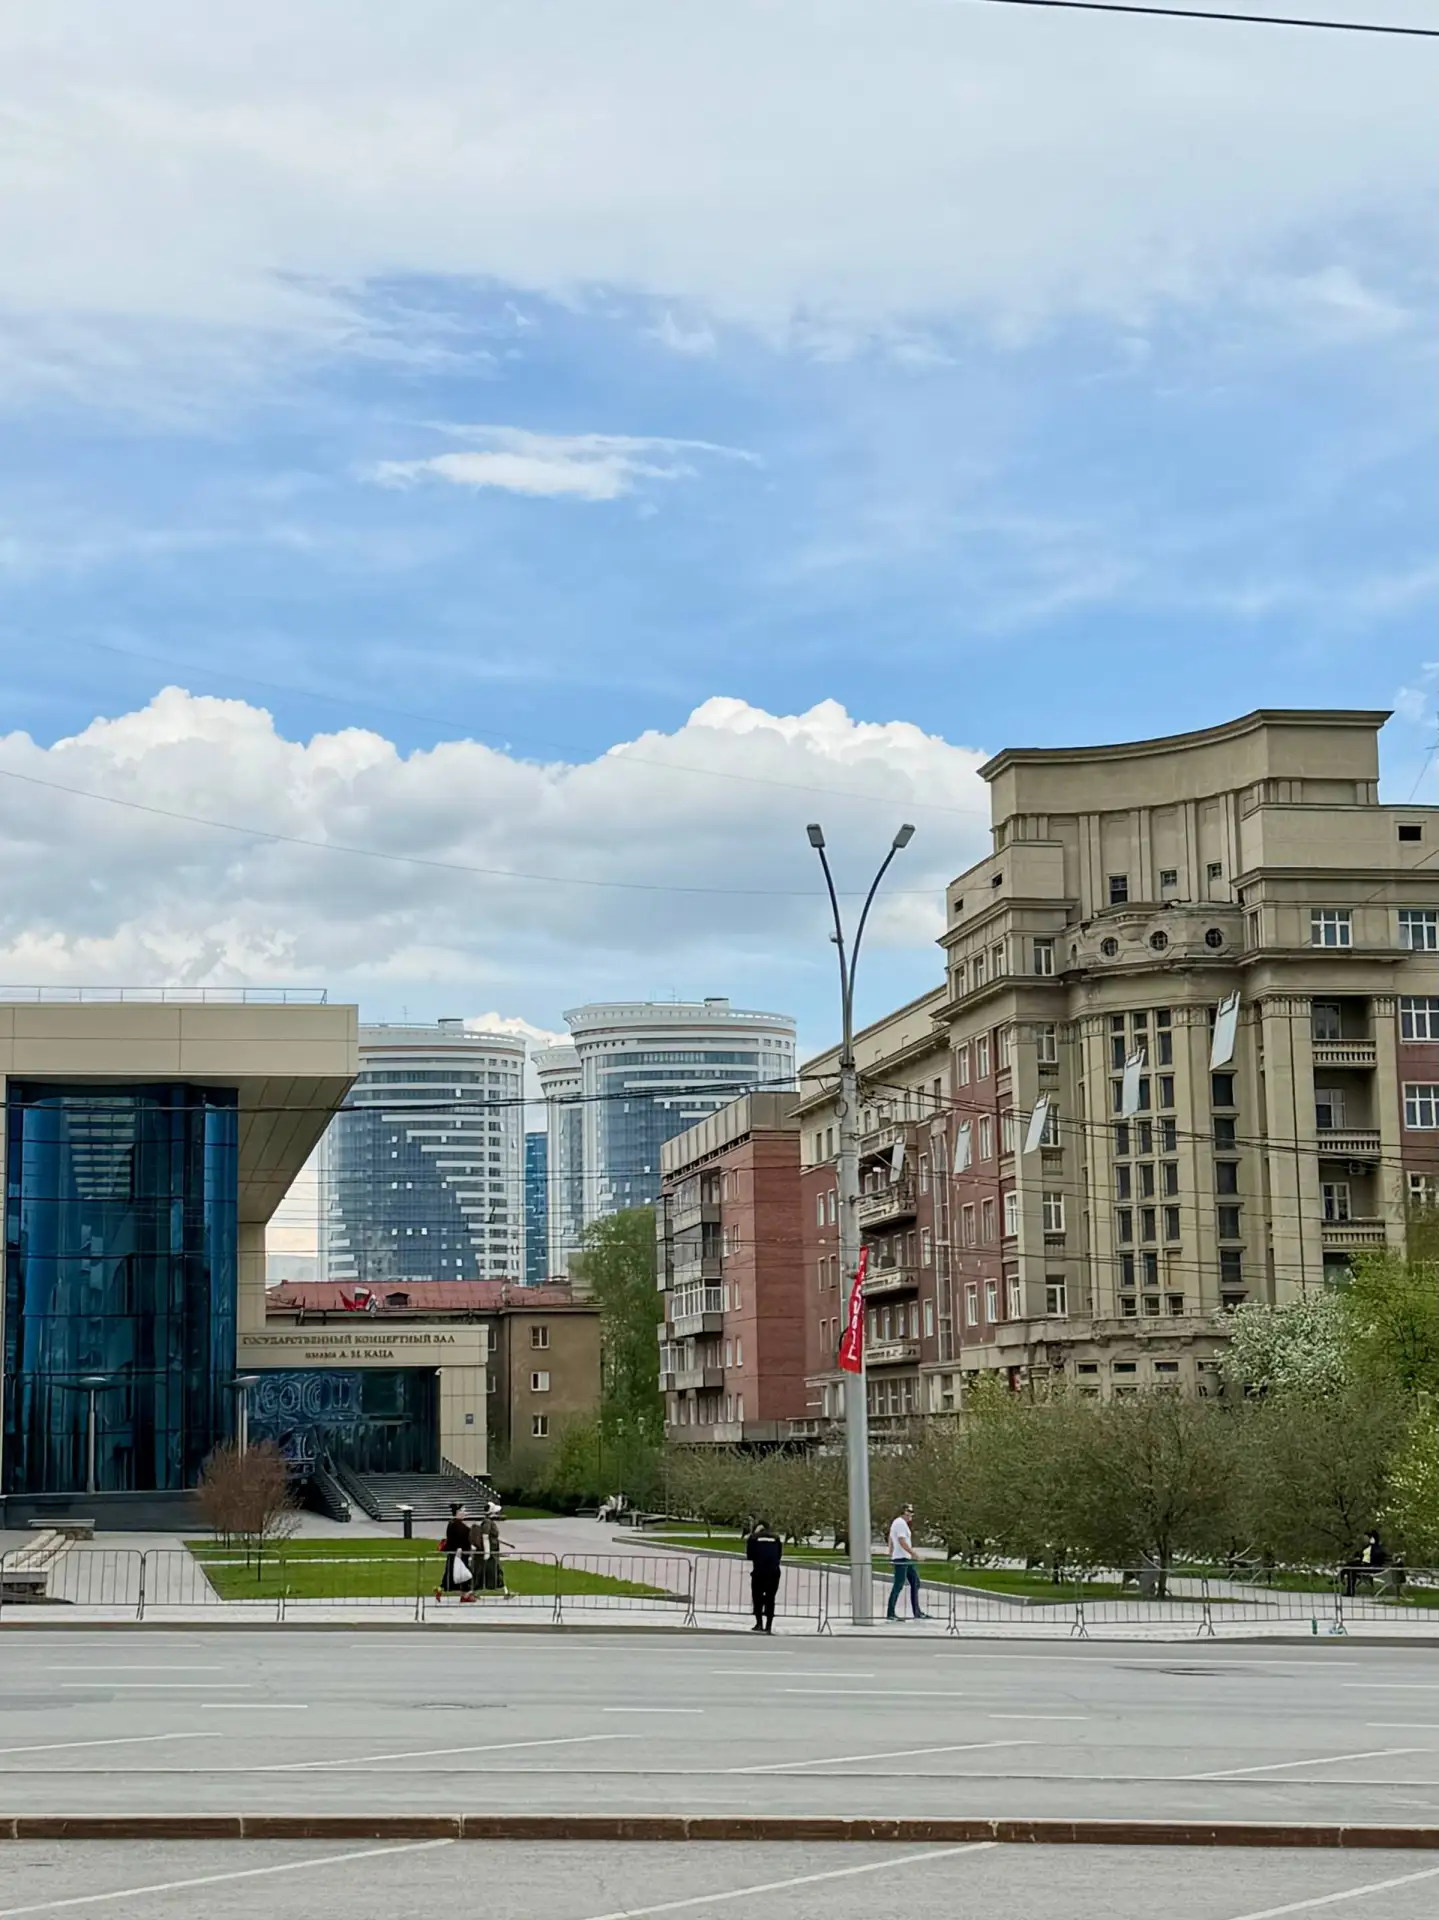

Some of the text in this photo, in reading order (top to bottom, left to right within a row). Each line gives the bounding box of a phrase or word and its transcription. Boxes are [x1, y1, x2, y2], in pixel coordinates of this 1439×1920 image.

[243, 1334, 455, 1345] ГОСУДАРСТВЕННЫЙ КОНЦЕРТНЫЙ ЗАЛ
[364, 1350, 394, 1359] КАЦА
